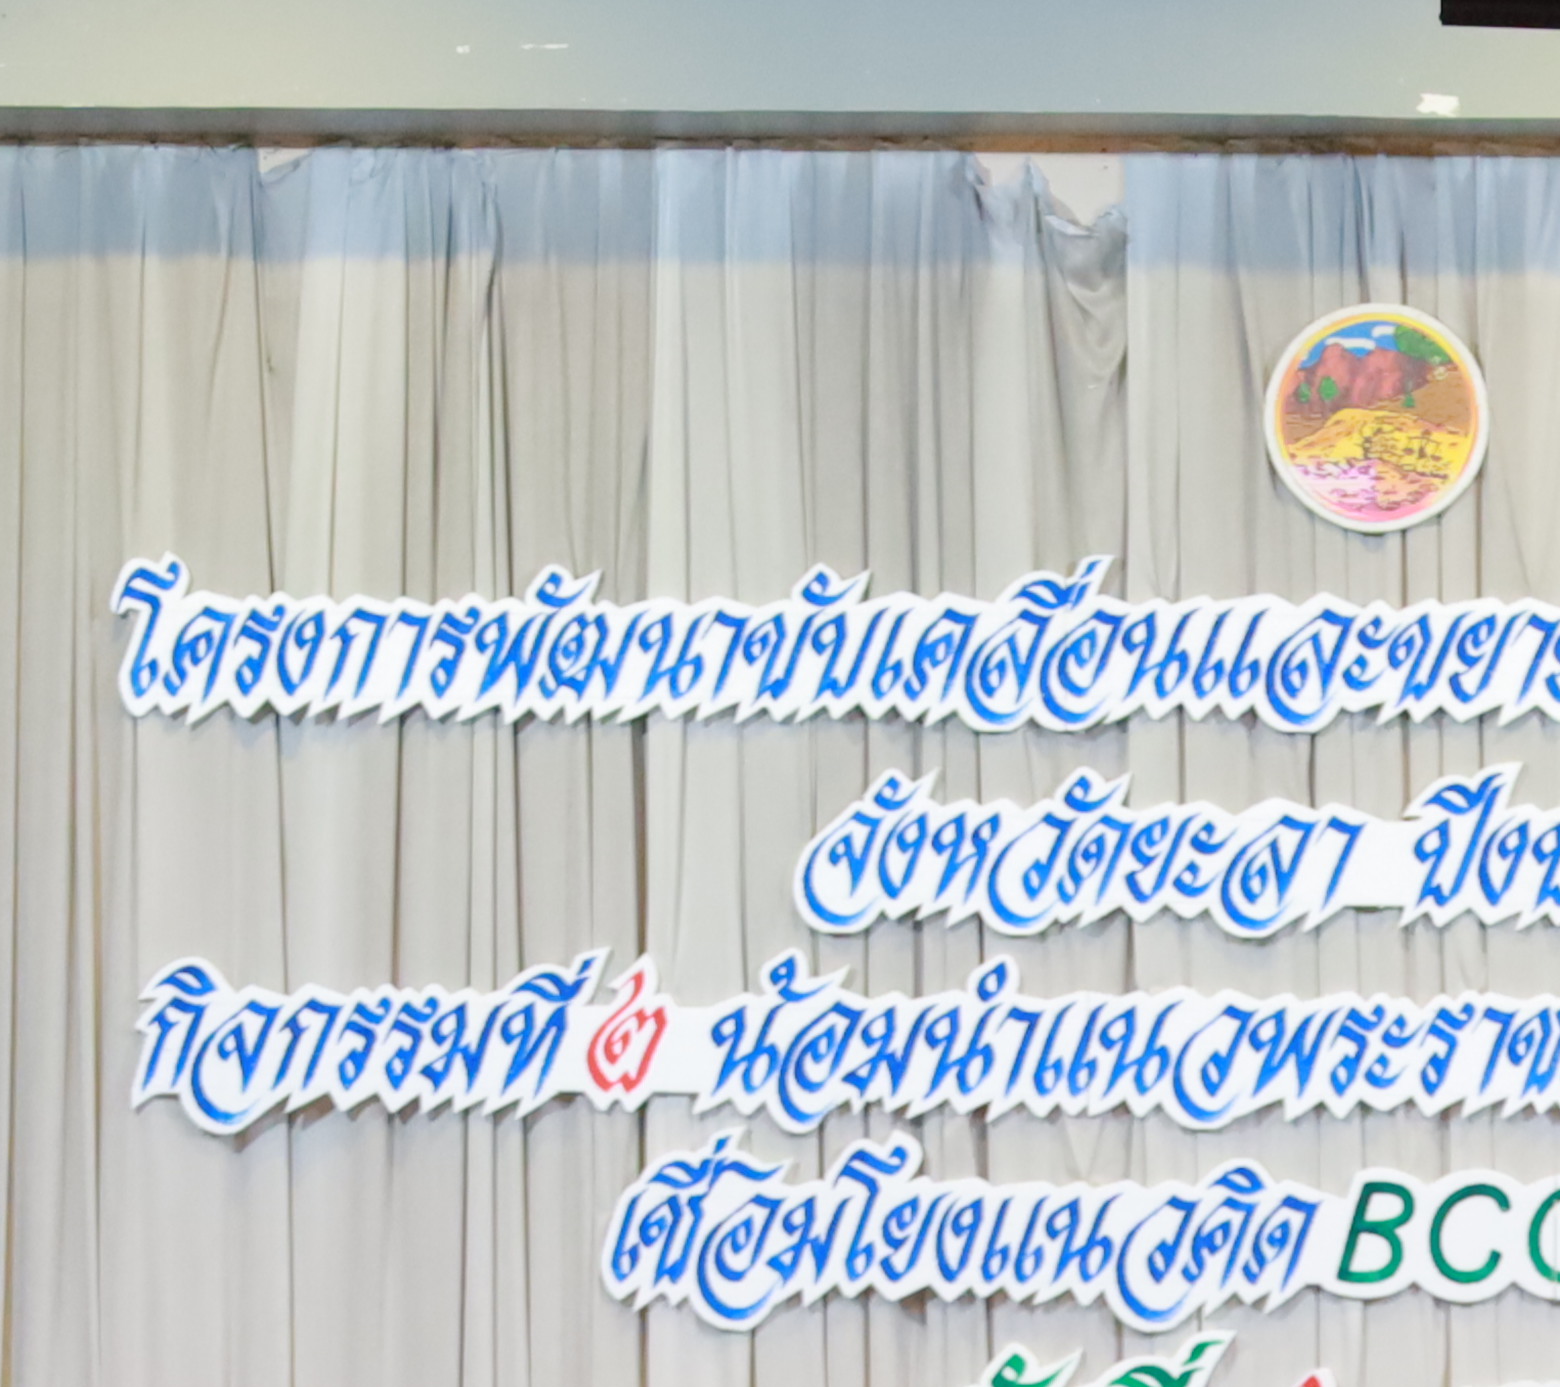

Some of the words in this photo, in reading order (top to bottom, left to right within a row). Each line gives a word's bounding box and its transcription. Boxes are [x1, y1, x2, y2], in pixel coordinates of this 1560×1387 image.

[802, 775, 1364, 931] จังหวัดยะลา
[610, 1136, 1320, 1322] เชื่อมโยงแนวคิด
